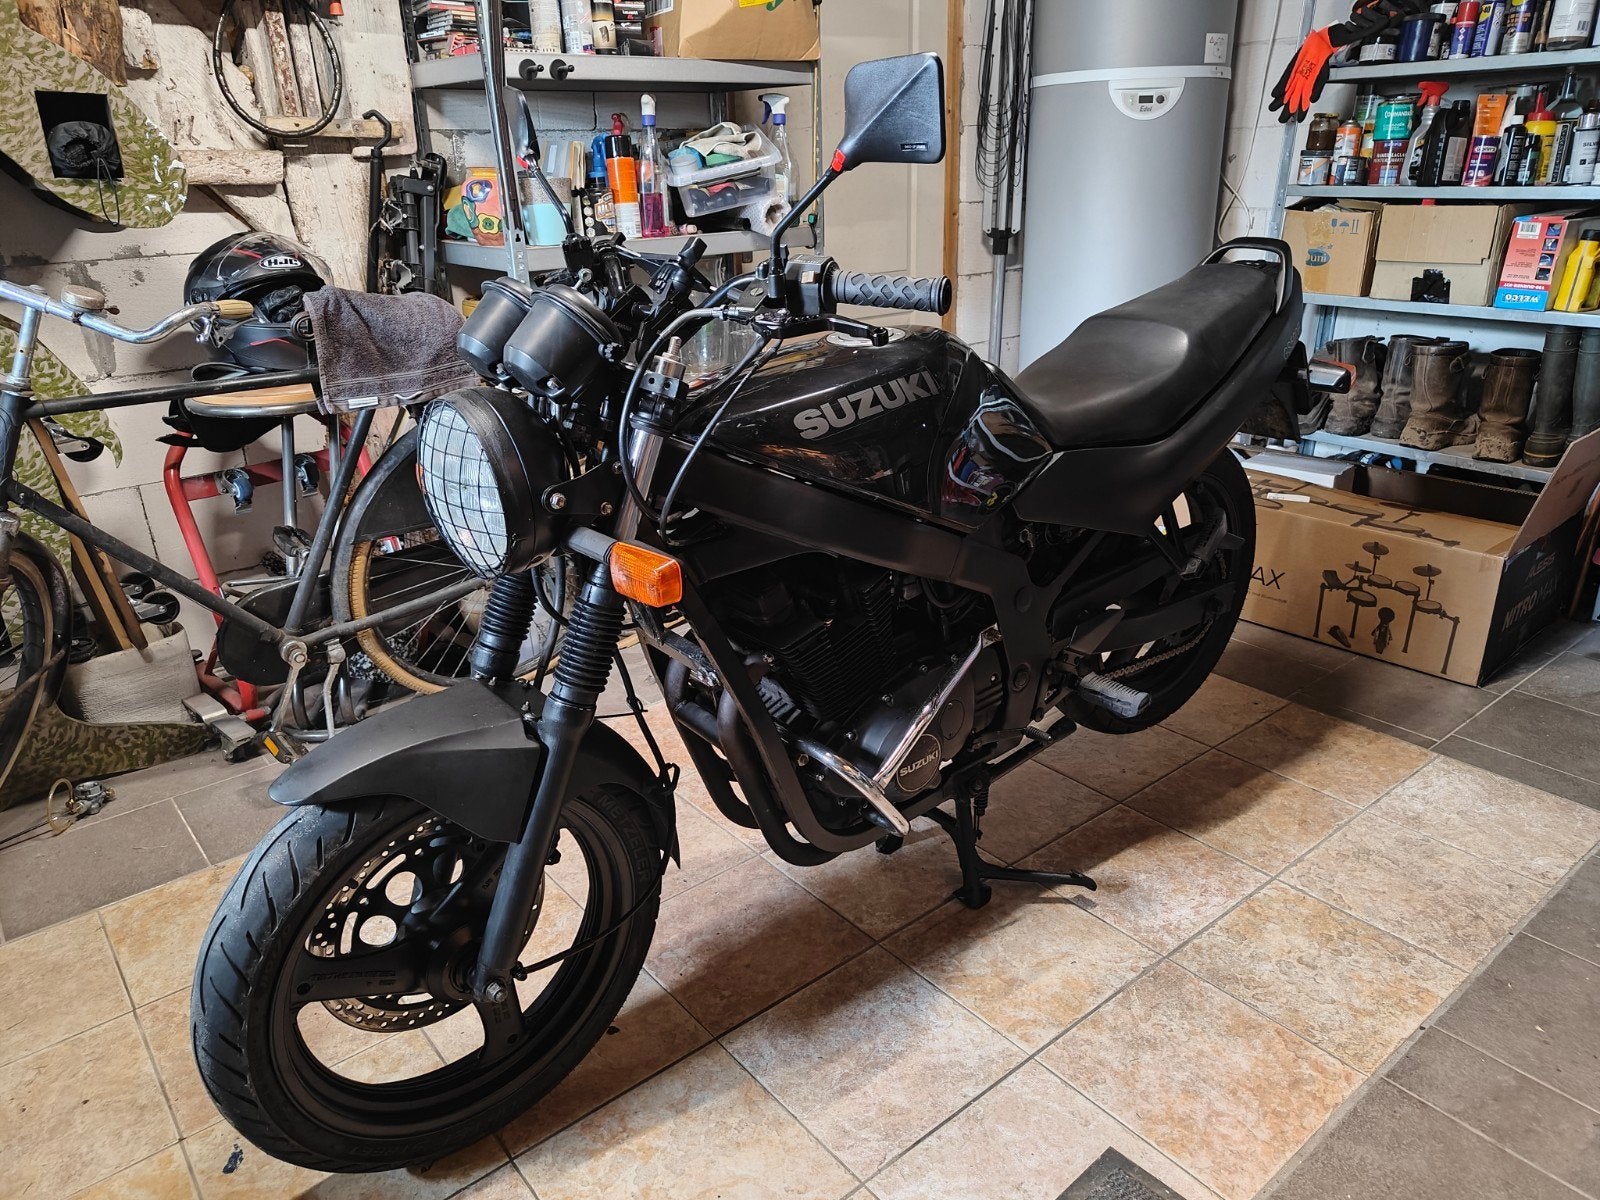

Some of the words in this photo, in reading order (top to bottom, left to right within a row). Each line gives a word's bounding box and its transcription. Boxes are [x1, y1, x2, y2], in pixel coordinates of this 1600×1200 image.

[267, 258, 299, 267] HJC
[1504, 293, 1540, 304] WELCO
[793, 370, 940, 440] SUZUKI
[1501, 590, 1538, 632] NITRO
[899, 749, 939, 777] SUZUKI
